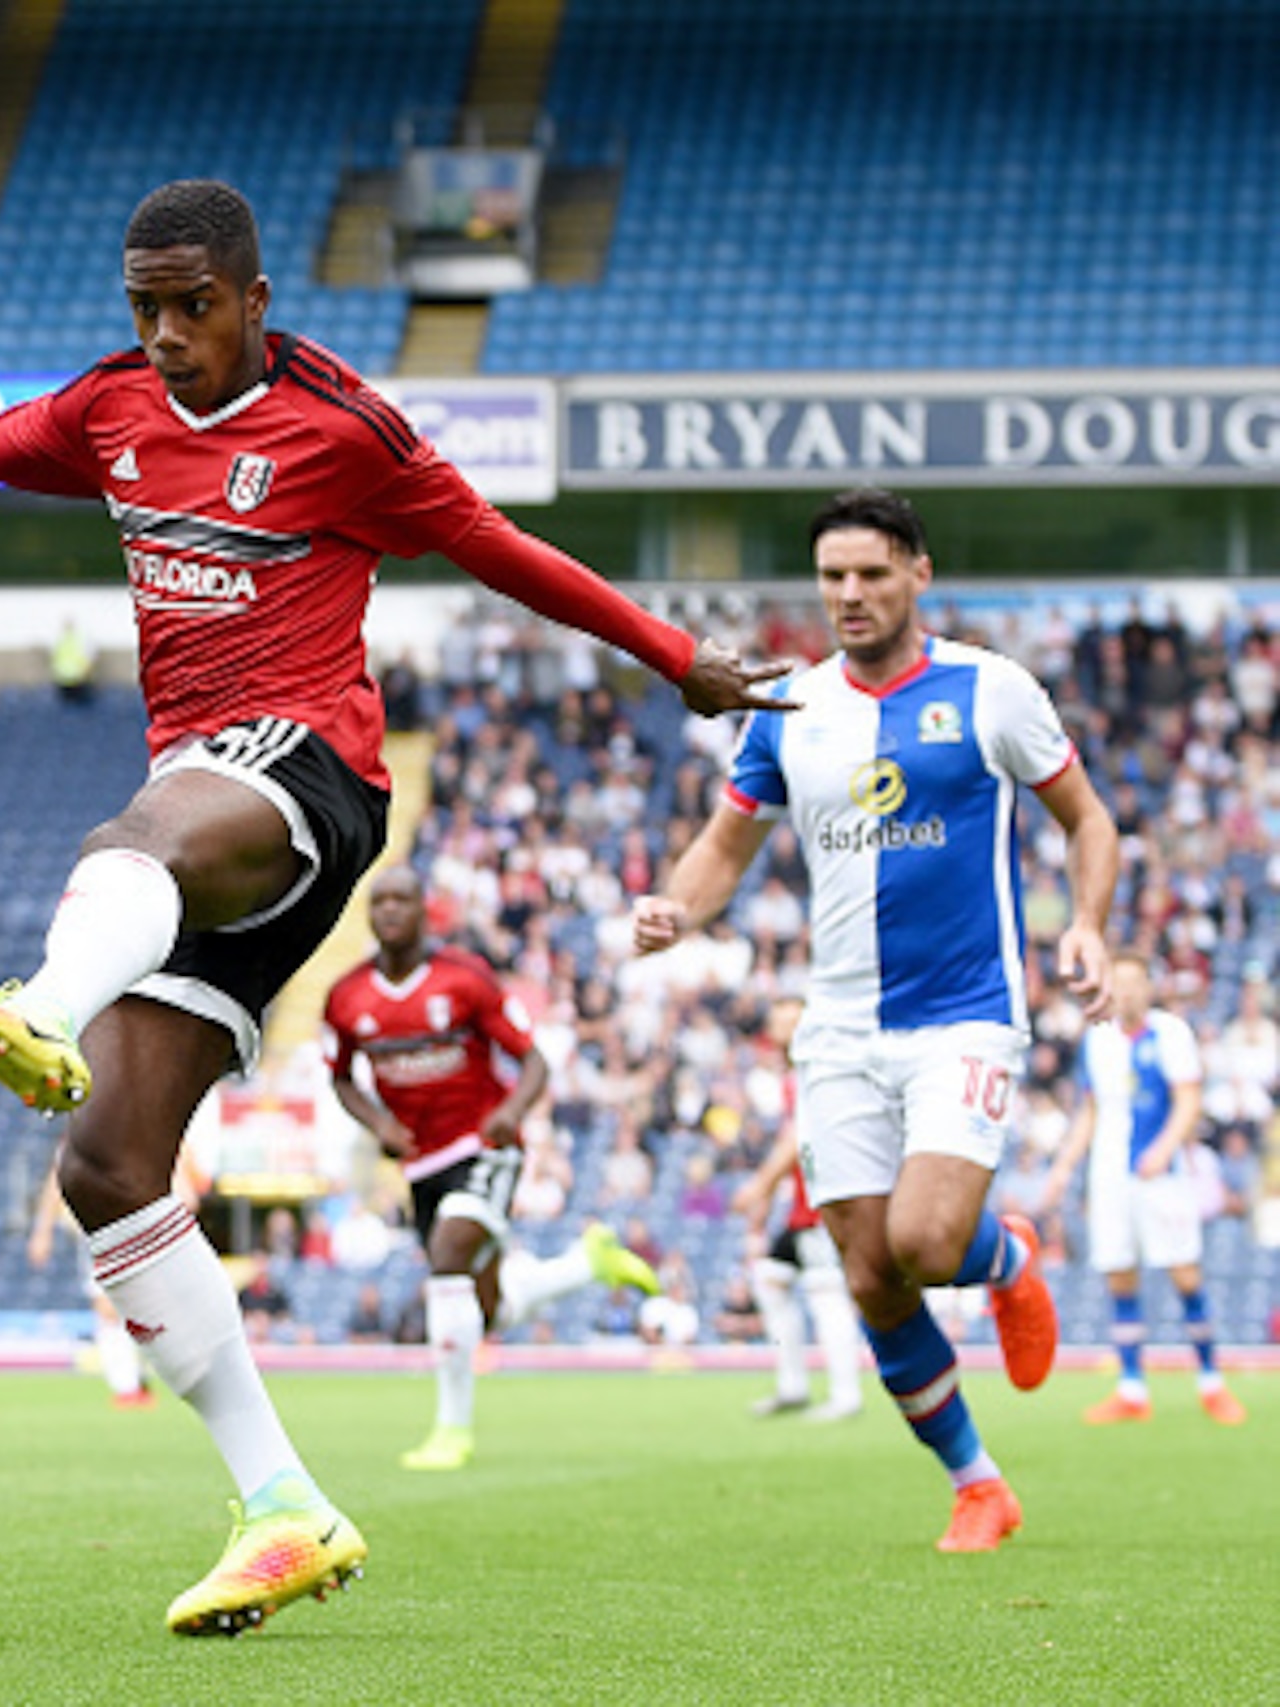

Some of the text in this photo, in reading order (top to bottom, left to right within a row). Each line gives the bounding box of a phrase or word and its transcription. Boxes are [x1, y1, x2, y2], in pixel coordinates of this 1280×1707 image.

[598, 397, 1280, 468] BRYAN DOUG
[143, 554, 258, 601] FLORIDA
[819, 814, 946, 852] dafabet
[960, 1055, 1009, 1121] 10
